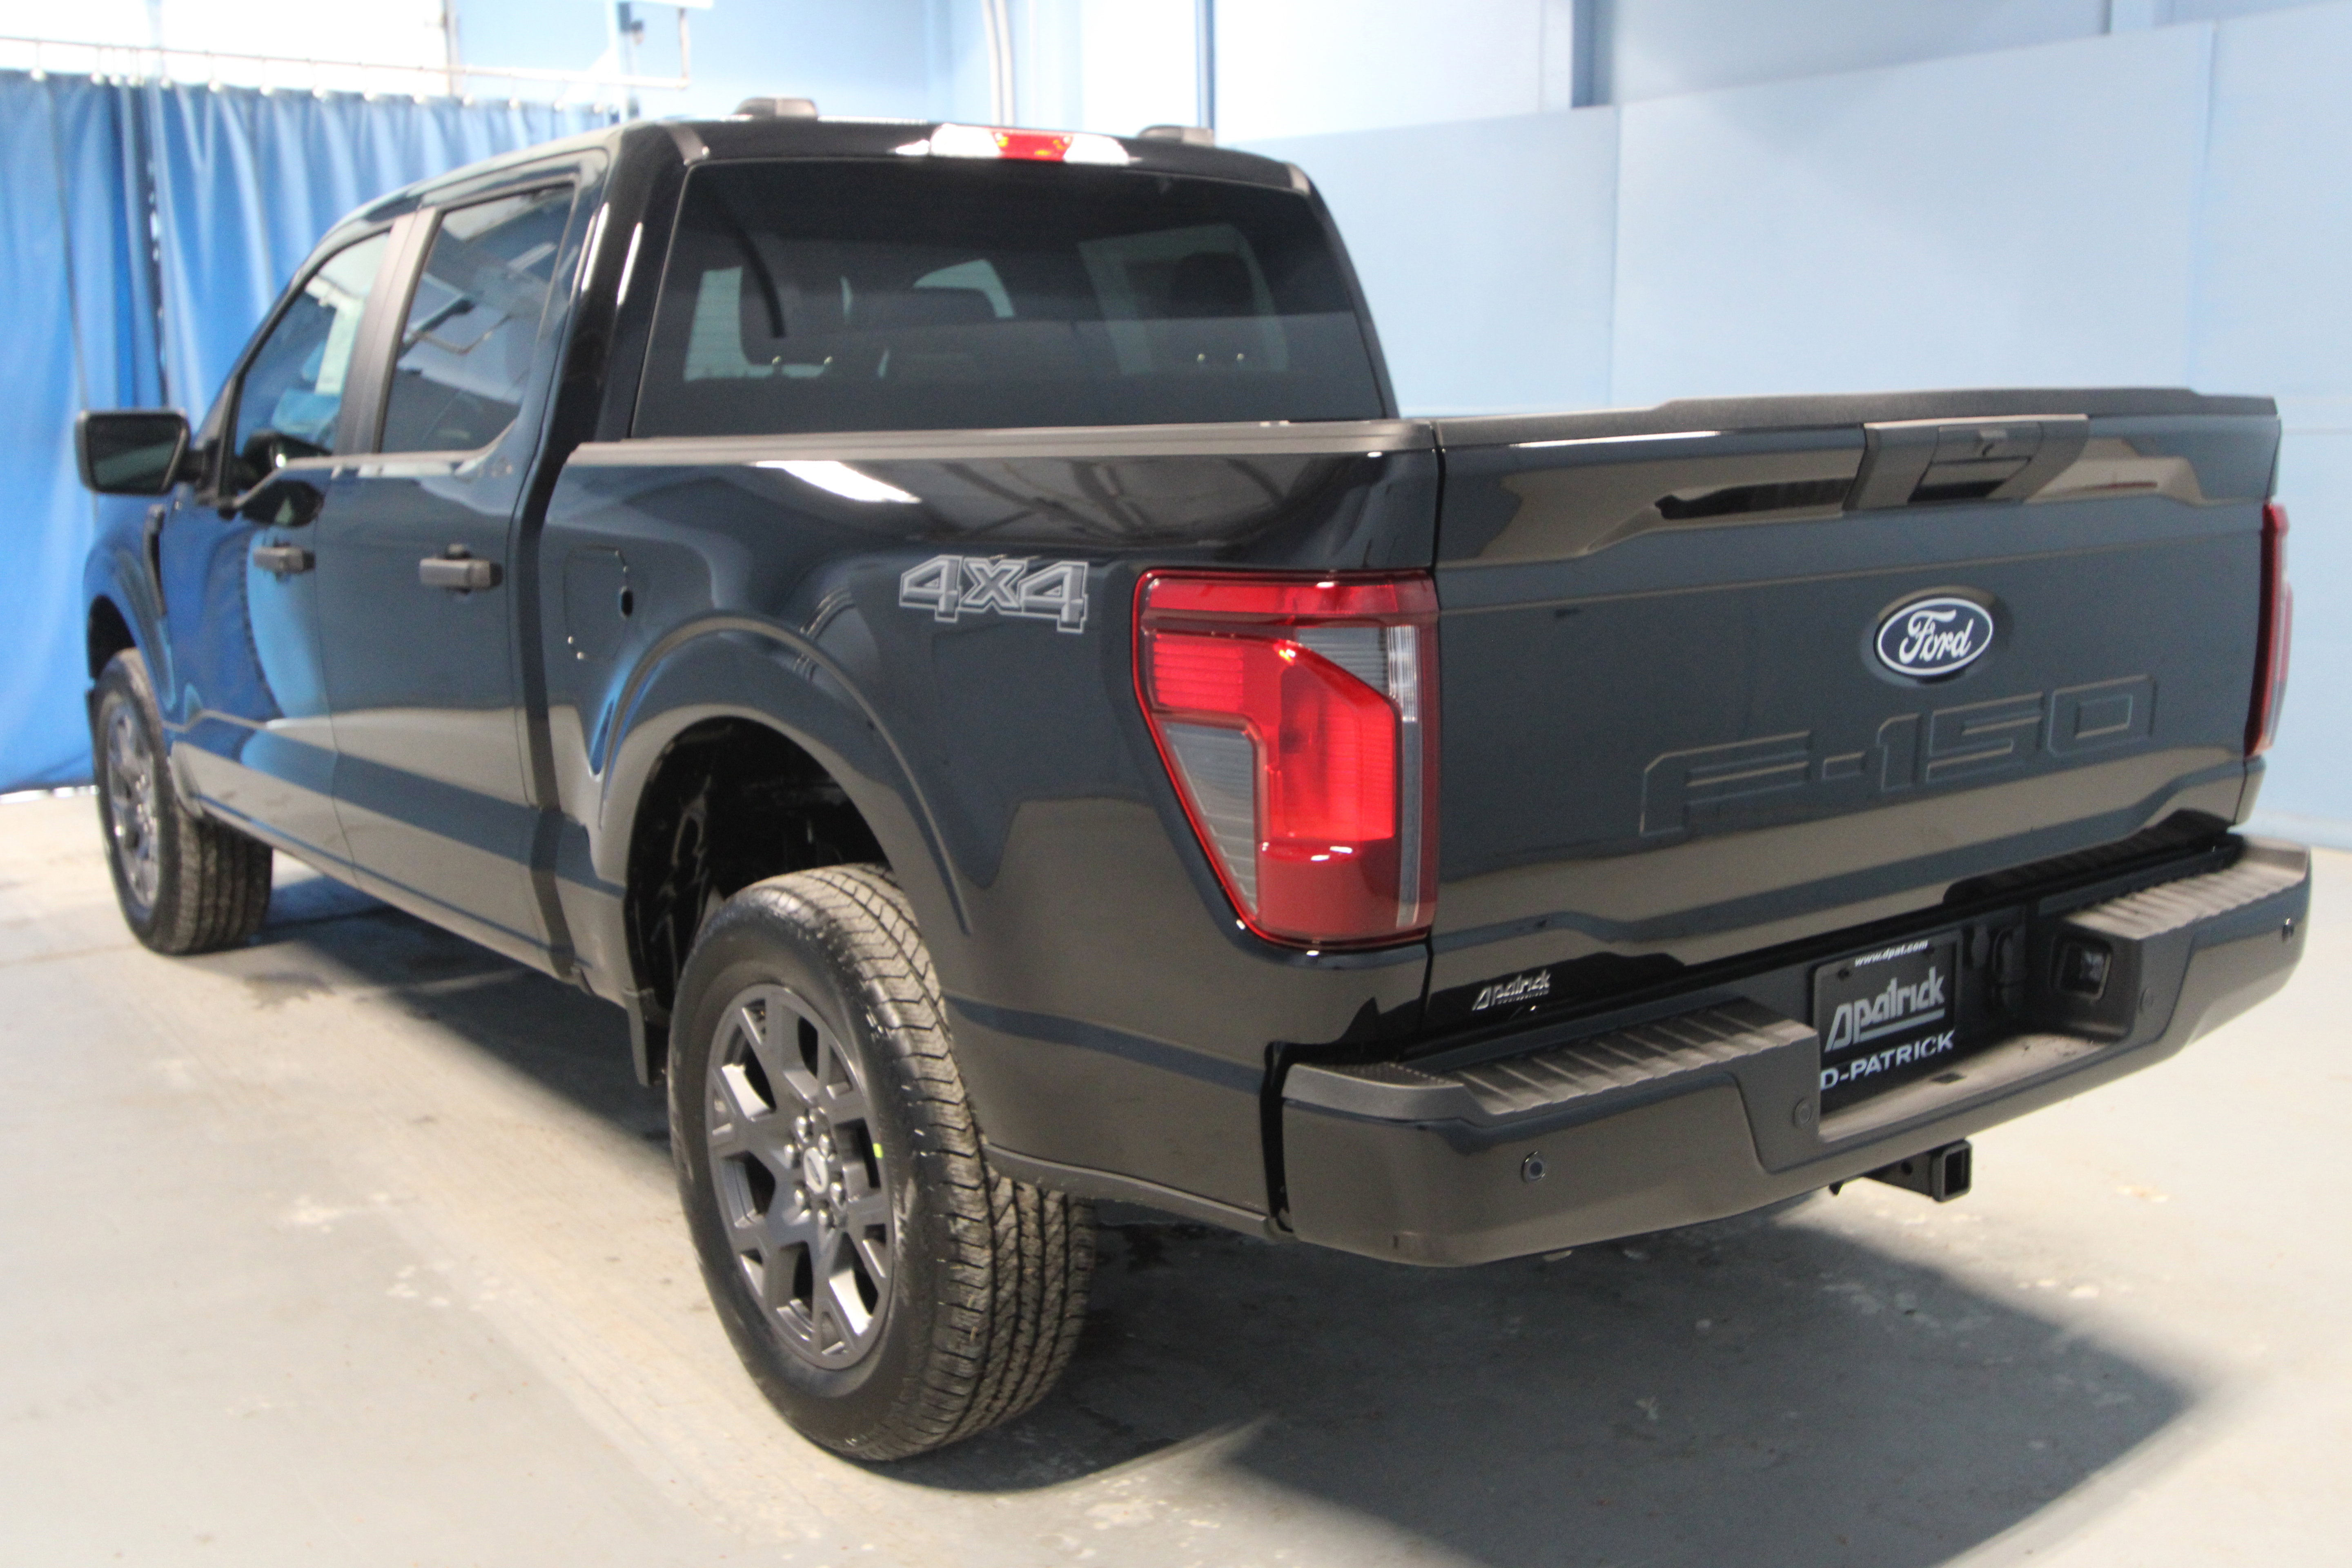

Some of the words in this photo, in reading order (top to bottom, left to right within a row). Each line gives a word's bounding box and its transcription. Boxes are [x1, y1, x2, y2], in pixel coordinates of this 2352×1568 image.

[1899, 609, 1974, 664] Ford
[1638, 674, 2155, 837] F-150
[1855, 940, 1928, 967] www.dpat.com
[1820, 1028, 1955, 1091] D-PATRICK
